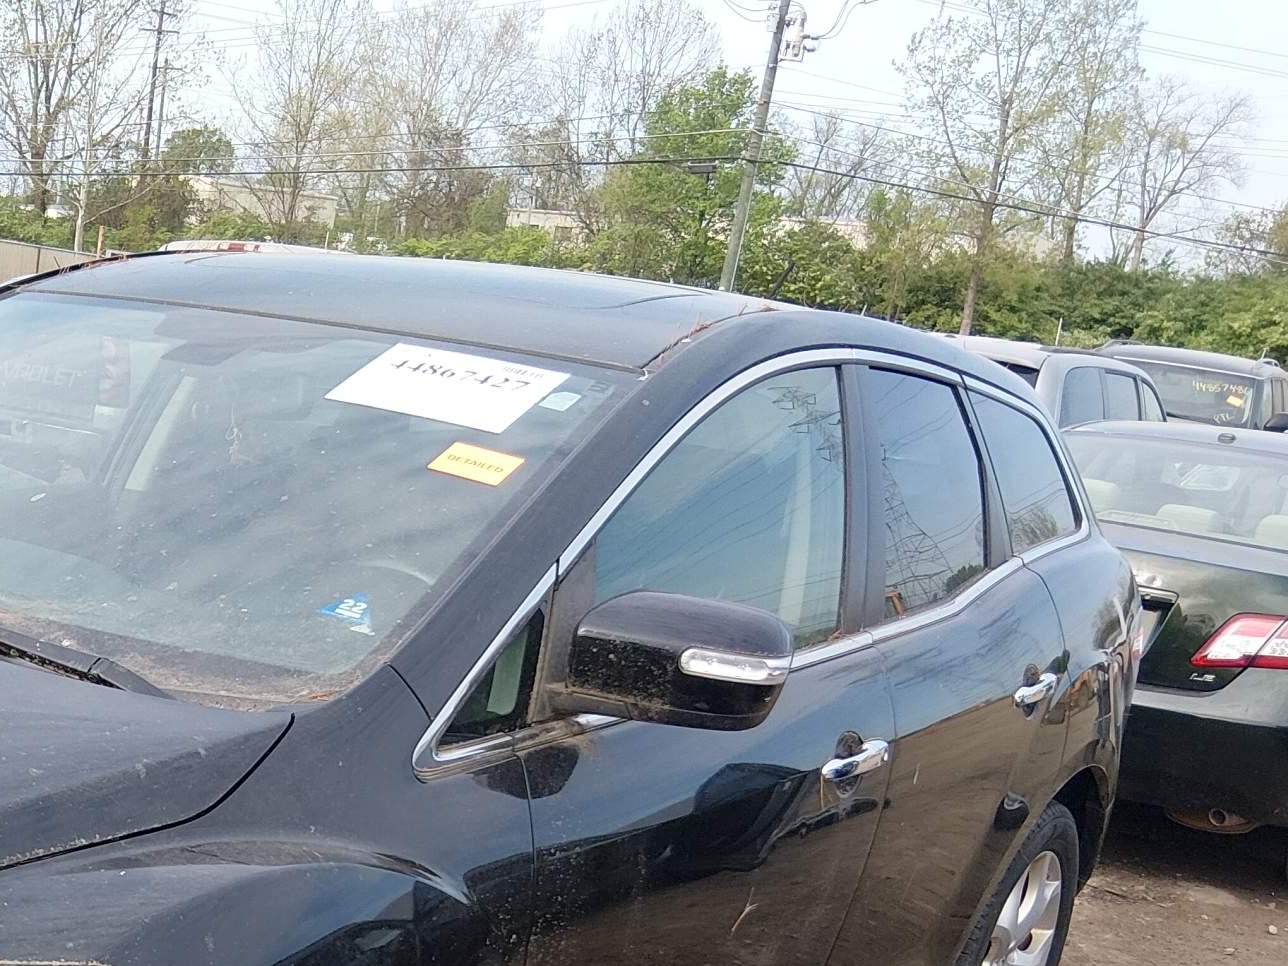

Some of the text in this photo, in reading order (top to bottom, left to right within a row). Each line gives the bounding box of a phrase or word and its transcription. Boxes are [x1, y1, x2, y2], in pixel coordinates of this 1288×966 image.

[391, 358, 530, 391] 44867427
[447, 453, 505, 473] DETAILED
[338, 598, 368, 614] 22
[1189, 672, 1216, 682] LE
